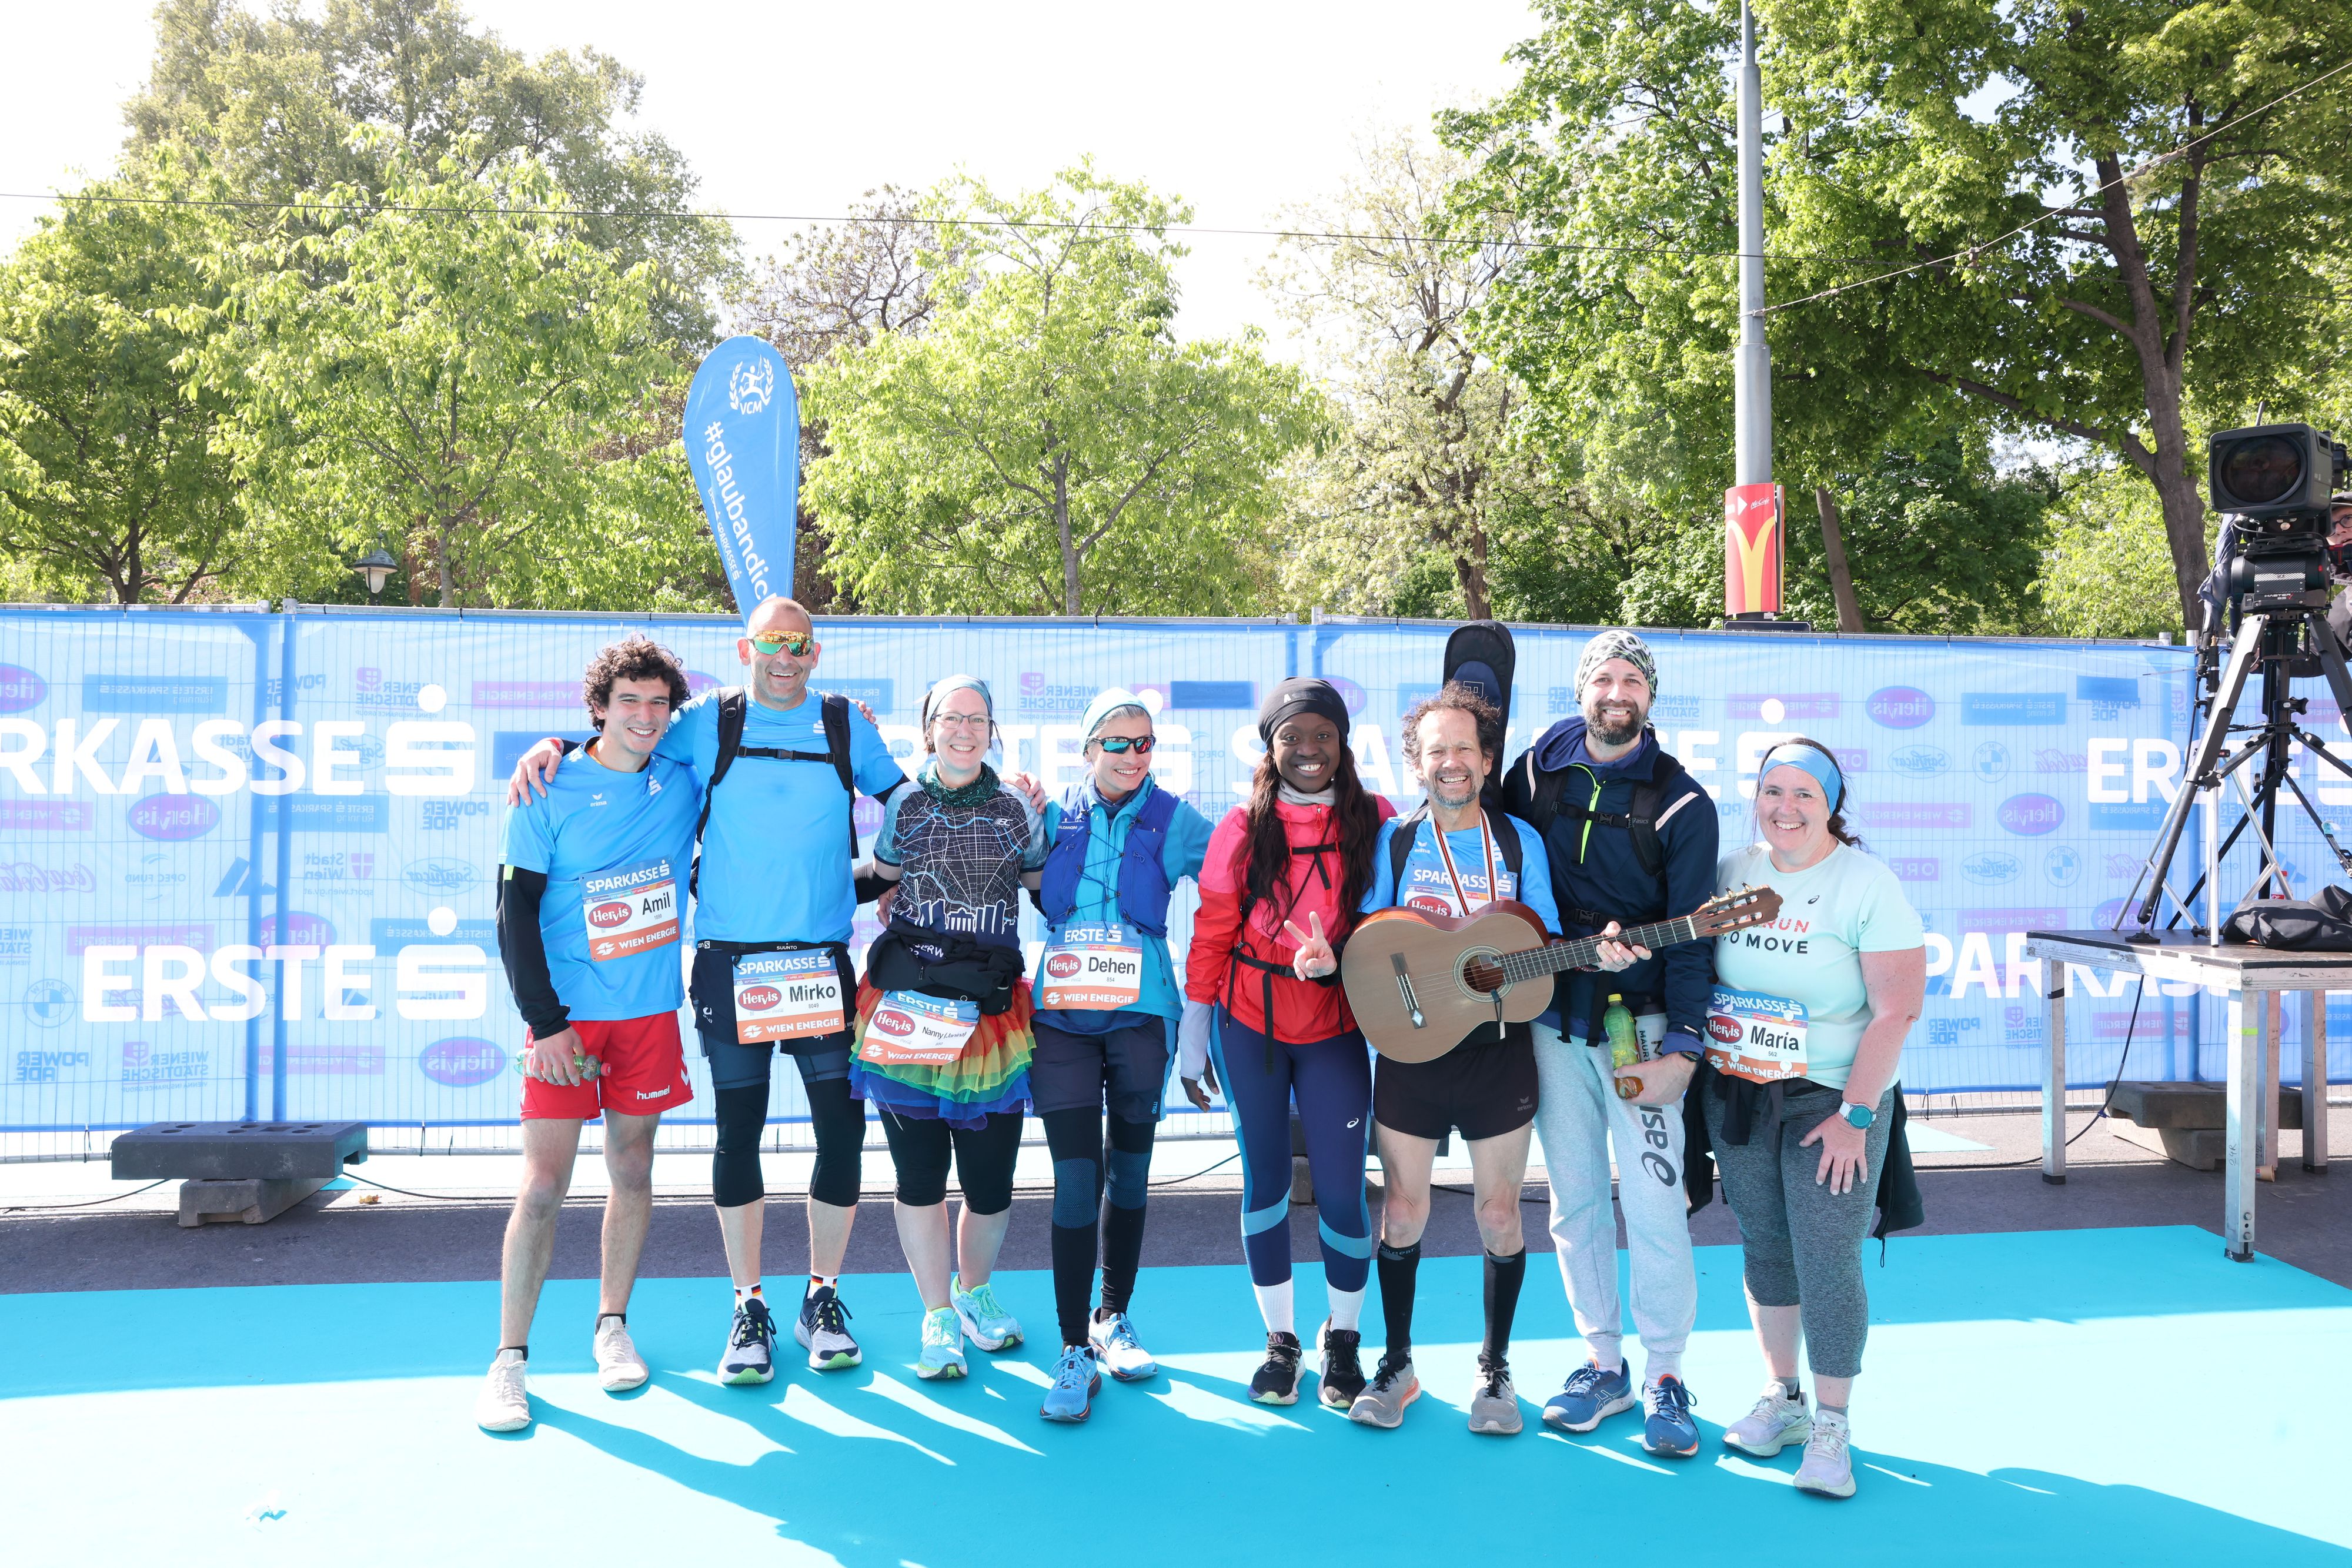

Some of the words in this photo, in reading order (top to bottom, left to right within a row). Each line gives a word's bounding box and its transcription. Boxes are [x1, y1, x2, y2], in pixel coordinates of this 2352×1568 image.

[739, 400, 762, 415] VCM
[704, 420, 777, 607] #glaubandic
[717, 522, 737, 571] SPARKASSE
[586, 866, 659, 894] SPARKASSE
[642, 891, 670, 915] Amil
[593, 907, 629, 922] Hervis
[619, 936, 644, 950] WIEN
[646, 926, 676, 943] ENERGIE
[1064, 928, 1104, 943] ERSTE
[1746, 934, 1808, 954] MOVE
[739, 956, 817, 975] SPARKASSE
[1050, 959, 1078, 973] Hervis
[1088, 957, 1135, 975] Dehen
[83, 945, 376, 1022] ERSTE
[790, 983, 836, 1002] Mirko
[743, 991, 779, 1005] Hervis
[897, 992, 941, 1014] ERSTE
[1064, 994, 1087, 1002] WIEN
[1090, 994, 1134, 1003] ENERGIE
[1714, 992, 1787, 1012] SPARKASSE
[766, 1022, 794, 1034] WIEN
[797, 1018, 840, 1030] ENERGIE
[877, 1012, 911, 1032] Hervis
[1709, 1019, 1739, 1038] Hervis
[922, 1027, 944, 1039] Nanny
[1750, 1025, 1799, 1051] Maria
[887, 1051, 912, 1059] WIEN
[1728, 1061, 1752, 1074] WIEN
[1753, 1068, 1800, 1079] ENERGIE
[637, 1085, 670, 1100] hummel
[2229, 1144, 2237, 1166] 24R
